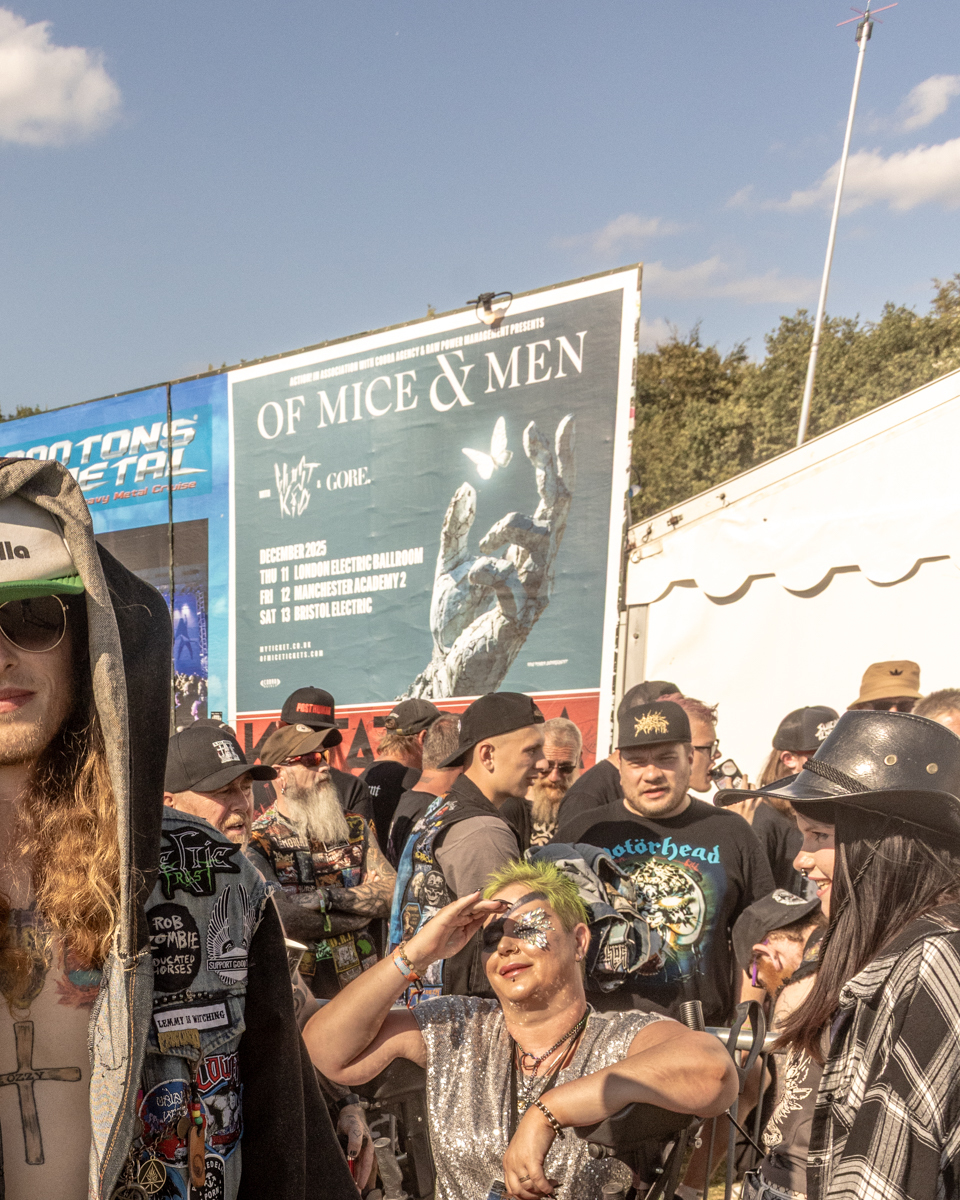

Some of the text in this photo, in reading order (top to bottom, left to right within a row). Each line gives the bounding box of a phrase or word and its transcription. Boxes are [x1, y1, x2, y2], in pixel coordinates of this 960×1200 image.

[510, 317, 545, 335] PRESENTS
[257, 330, 588, 440] OF MICE & MEN
[76, 415, 198, 465] TONS
[73, 447, 208, 492] ETAL
[85, 480, 197, 506] eavy Metal Cruise
[259, 540, 327, 564] DECEMBER 2025
[259, 547, 424, 585] THU 11 LONDON ELECTRIC BALLROOM
[260, 571, 407, 605] FRI 12 MANCHESTER ACADEMY 2
[259, 597, 373, 625] SAT 13 BRISTOL ELECTRIC
[296, 702, 314, 713] POST
[153, 915, 184, 930] ROB
[153, 955, 195, 967] DUCATED
[154, 963, 193, 975] HORSES
[209, 961, 233, 970] SUPPORT
[157, 1016, 184, 1028] LEMMY
[6, 1071, 46, 1083] OZZY
